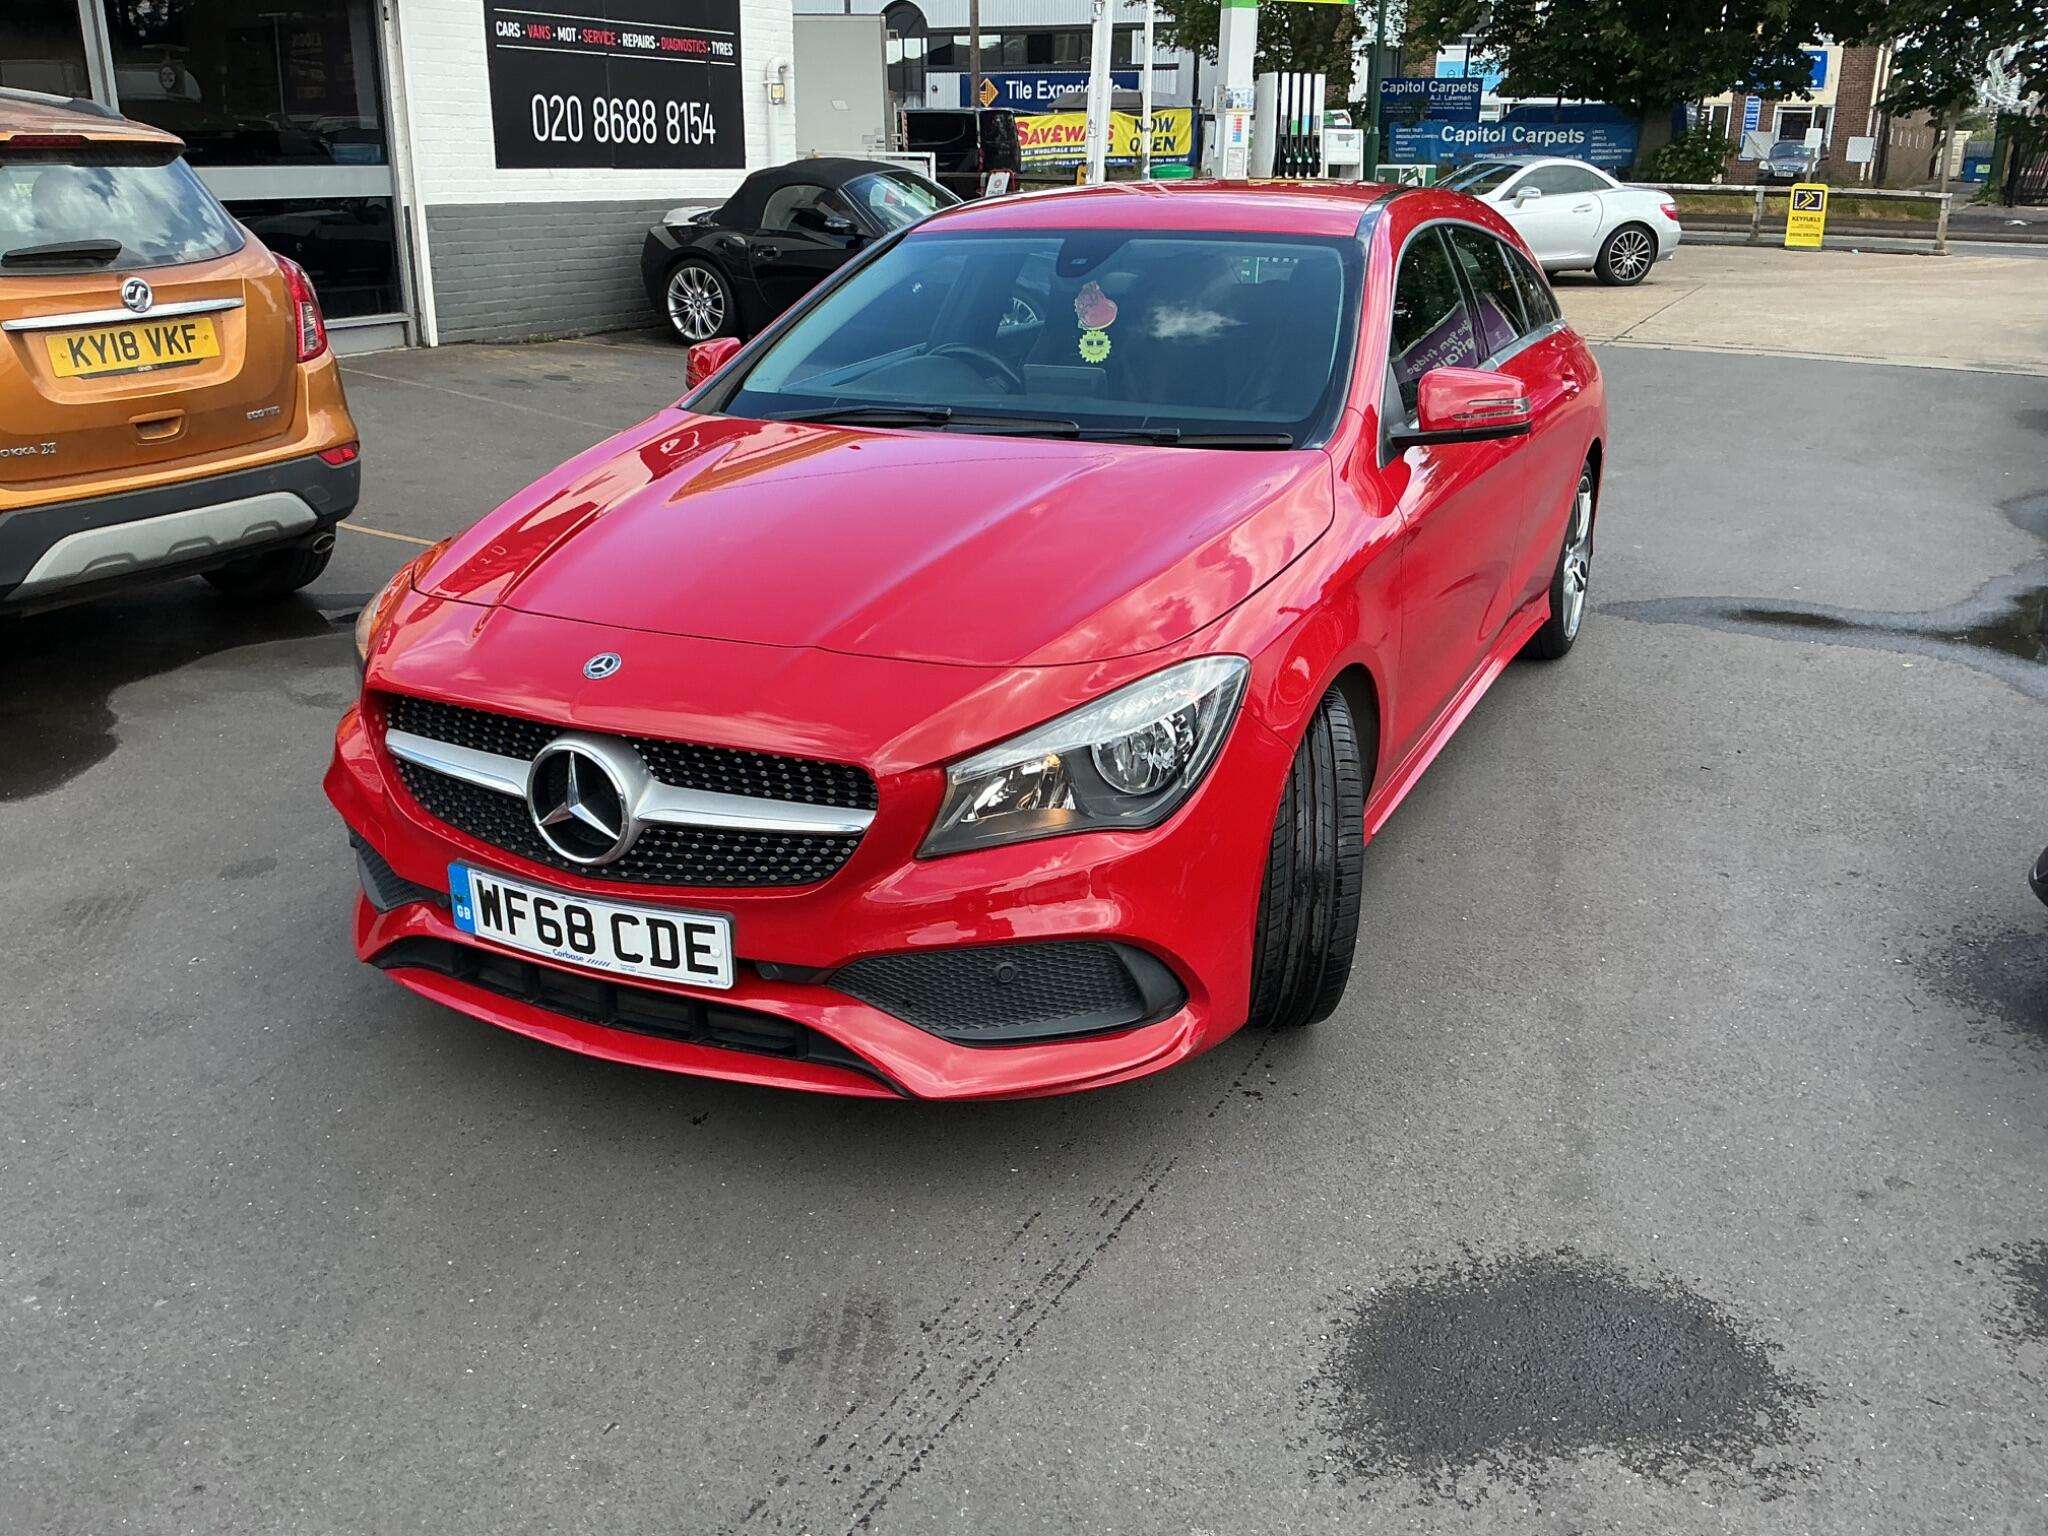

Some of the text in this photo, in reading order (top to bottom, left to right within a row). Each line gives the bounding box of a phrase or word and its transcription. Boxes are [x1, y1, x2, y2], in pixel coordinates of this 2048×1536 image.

[496, 21, 734, 56] CARS VANS MOT SERVICE REPAIRS DIAGNOSTICS TYRES
[1005, 79, 1032, 100] Tile
[1380, 80, 1479, 95] Capitol Carpets
[531, 94, 716, 145] 020 8688 8154
[1130, 135, 1176, 152] OEN
[1441, 125, 1585, 147] Capitol Carpets
[66, 323, 196, 368] KY18 VKF
[456, 904, 471, 920] GB
[476, 878, 719, 976] WF68 CDE
[552, 948, 585, 962] Carbase
